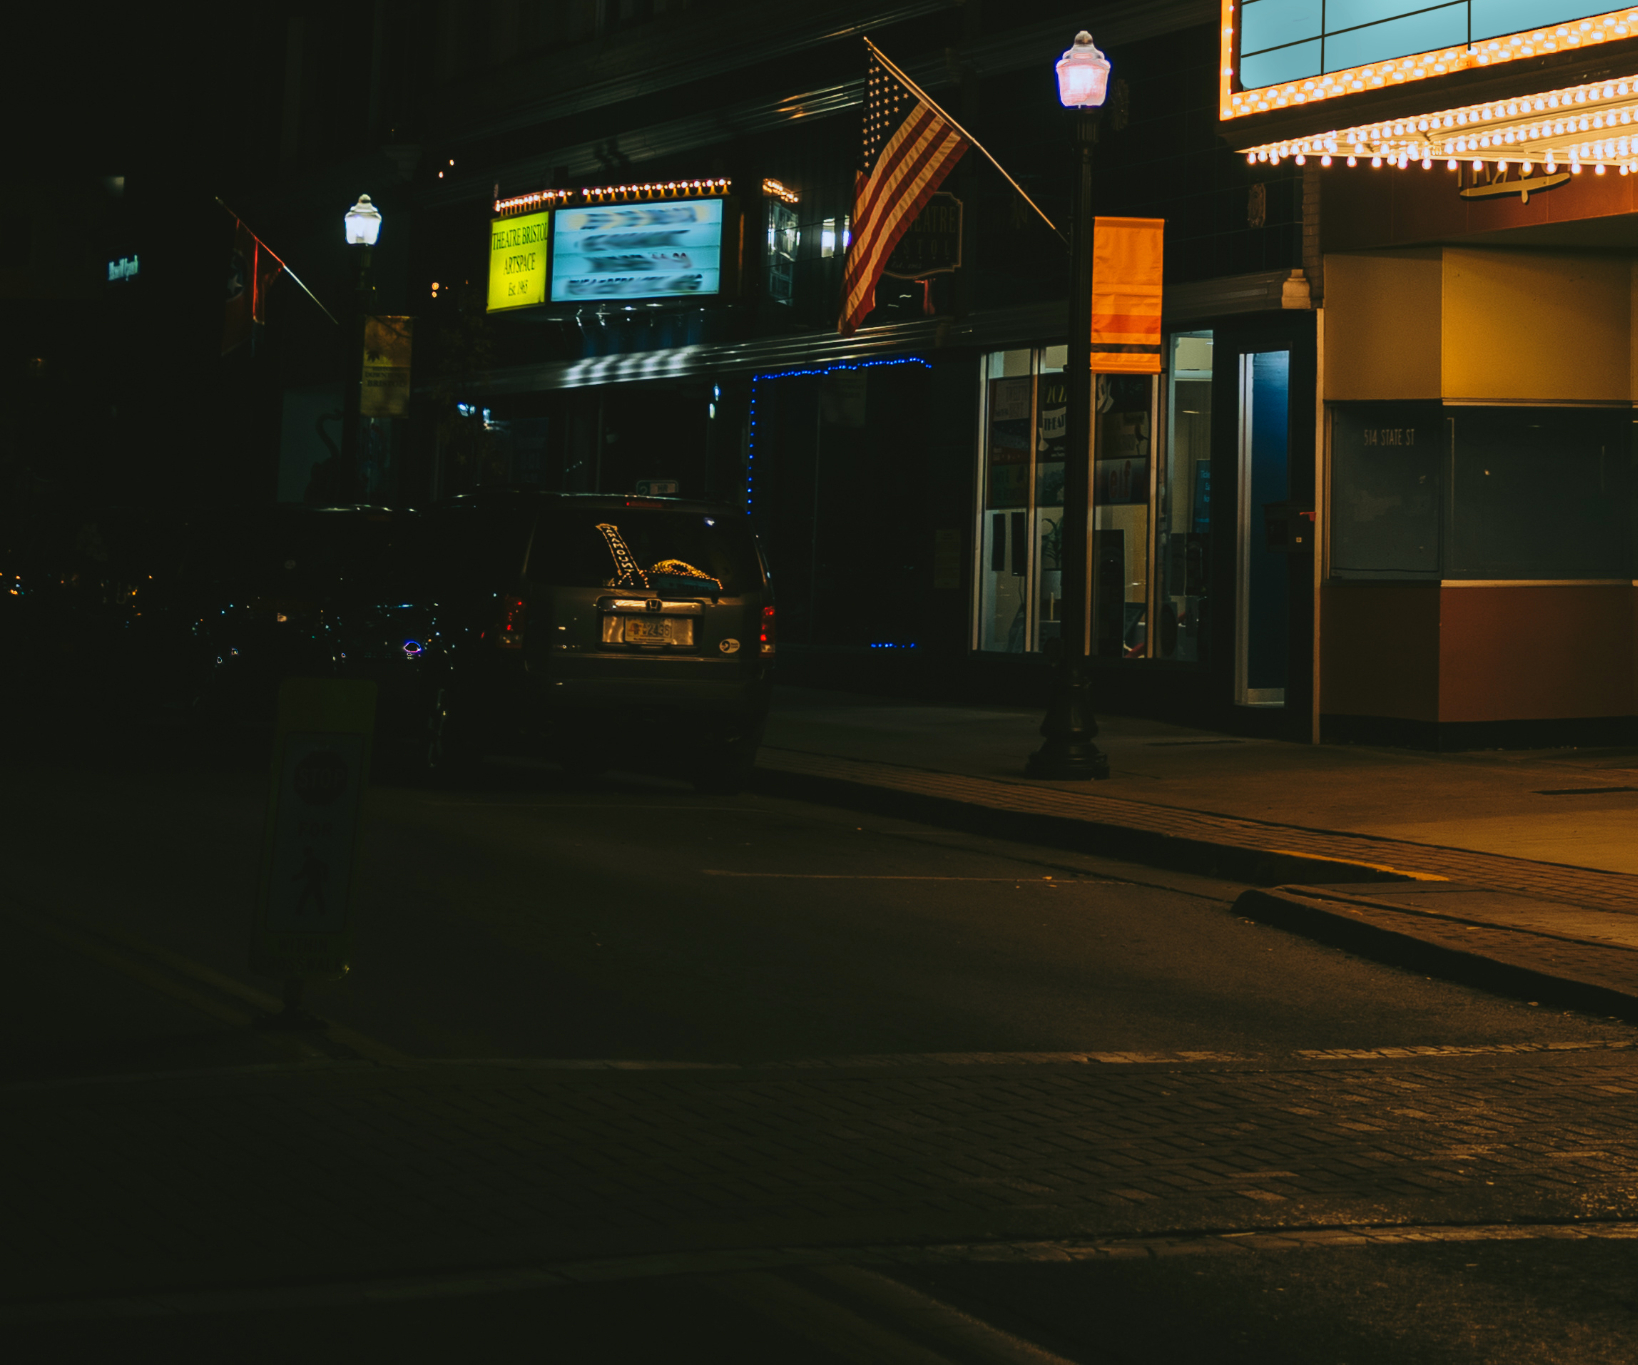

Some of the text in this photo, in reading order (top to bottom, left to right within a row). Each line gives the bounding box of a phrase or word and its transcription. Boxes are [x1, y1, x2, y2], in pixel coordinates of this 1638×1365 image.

[910, 205, 957, 233] EATRE
[493, 222, 549, 250] THEATRE BRISTOL
[503, 252, 537, 275] ARTSPACE
[1046, 384, 1067, 404] 202
[1364, 428, 1416, 446] 514 STATE ST
[298, 767, 346, 790] STOP
[298, 821, 333, 838] FOR
[279, 937, 328, 955] WITHIN
